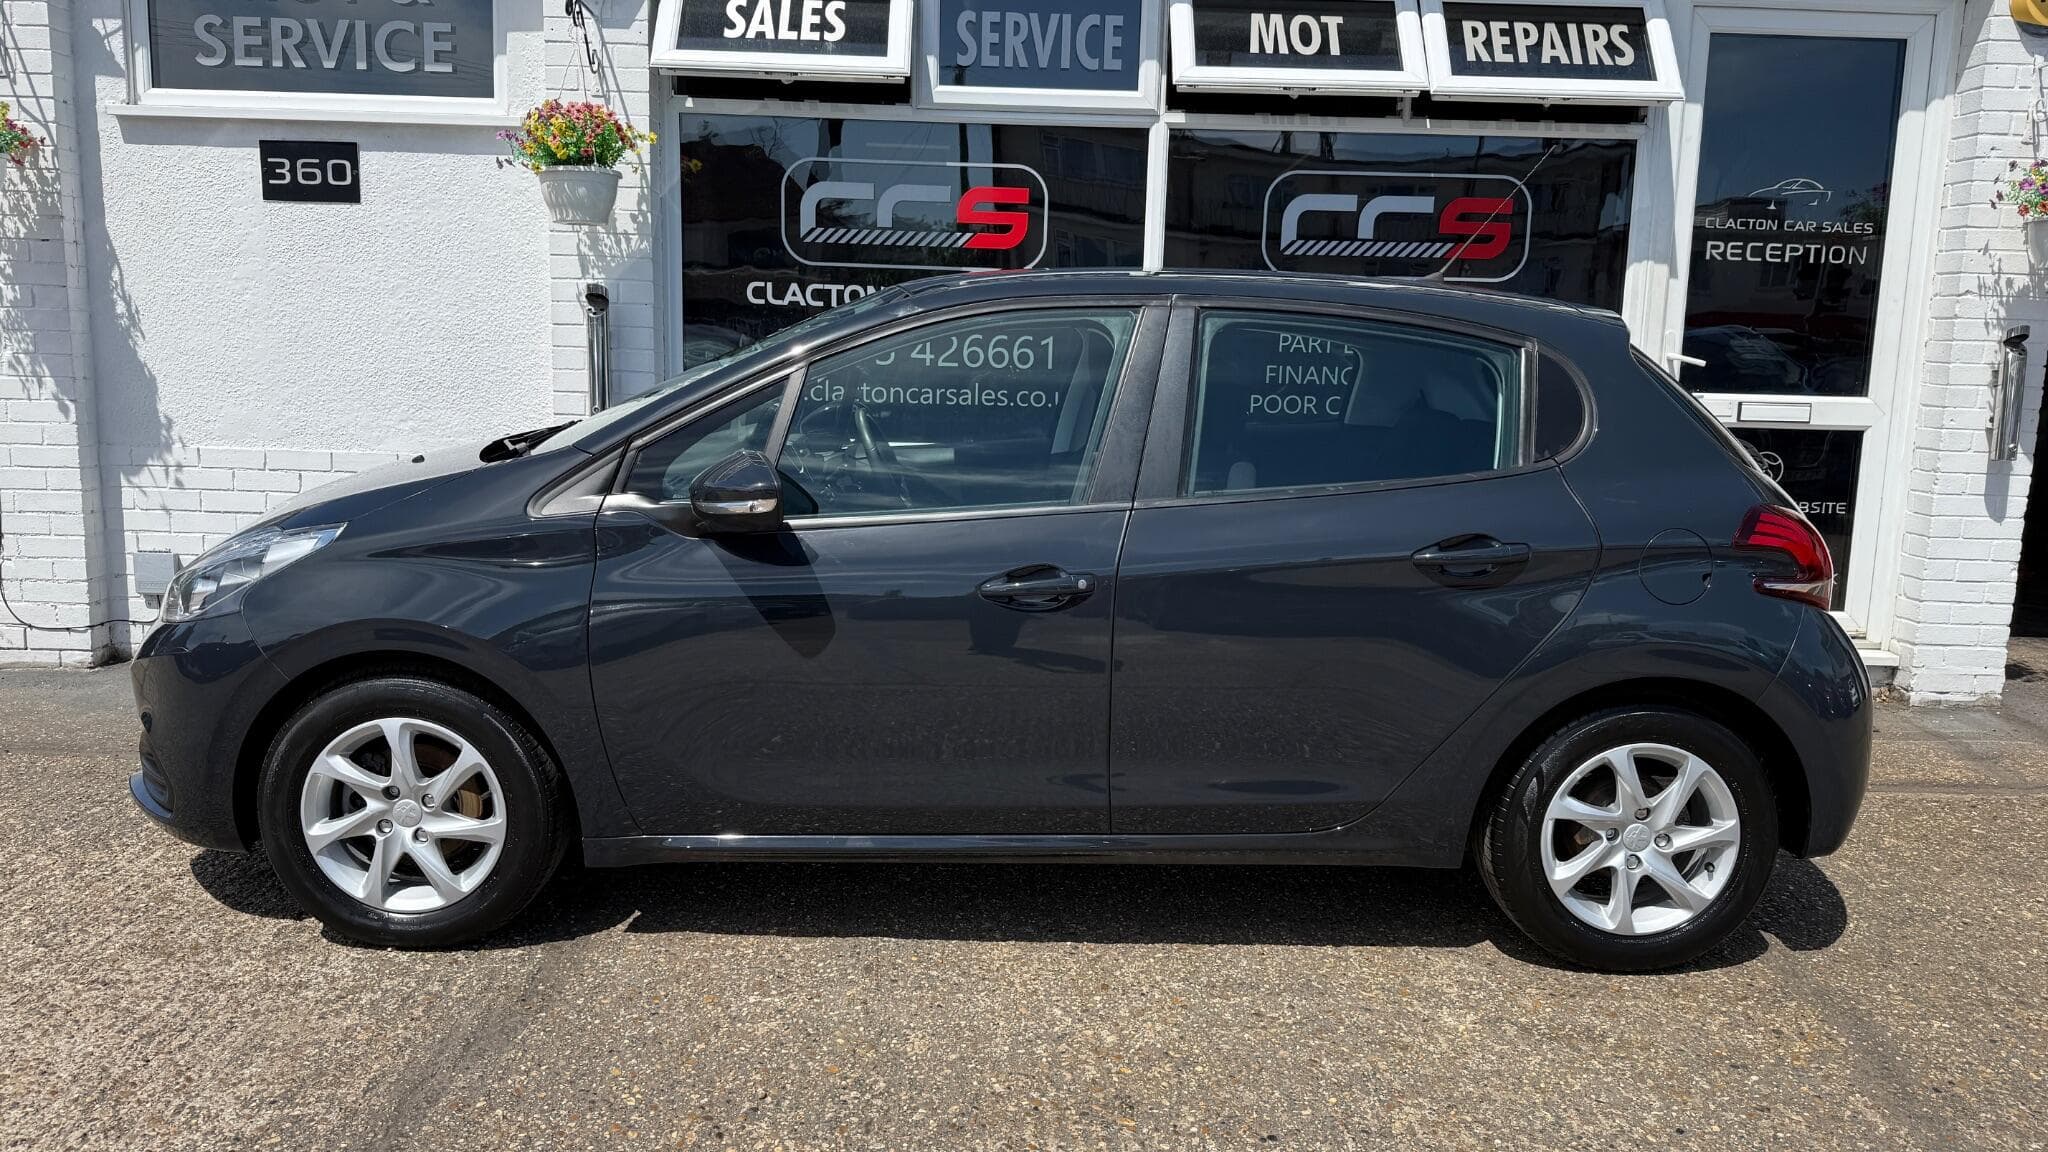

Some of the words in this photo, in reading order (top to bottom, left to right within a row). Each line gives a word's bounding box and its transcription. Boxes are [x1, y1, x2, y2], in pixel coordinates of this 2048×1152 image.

[724, 0, 847, 42] SALES
[956, 9, 1124, 72] SERVICE
[1249, 13, 1344, 56] MOT
[193, 14, 457, 73] SERVICE
[1461, 20, 1636, 67] REPAIRS
[267, 157, 352, 186] 360
[1705, 217, 1778, 231] CLACTON
[1784, 220, 1817, 232] CAR
[1821, 221, 1874, 234] SALES
[1705, 240, 1868, 265] RECEPTION
[1250, 394, 1318, 415] POOR
